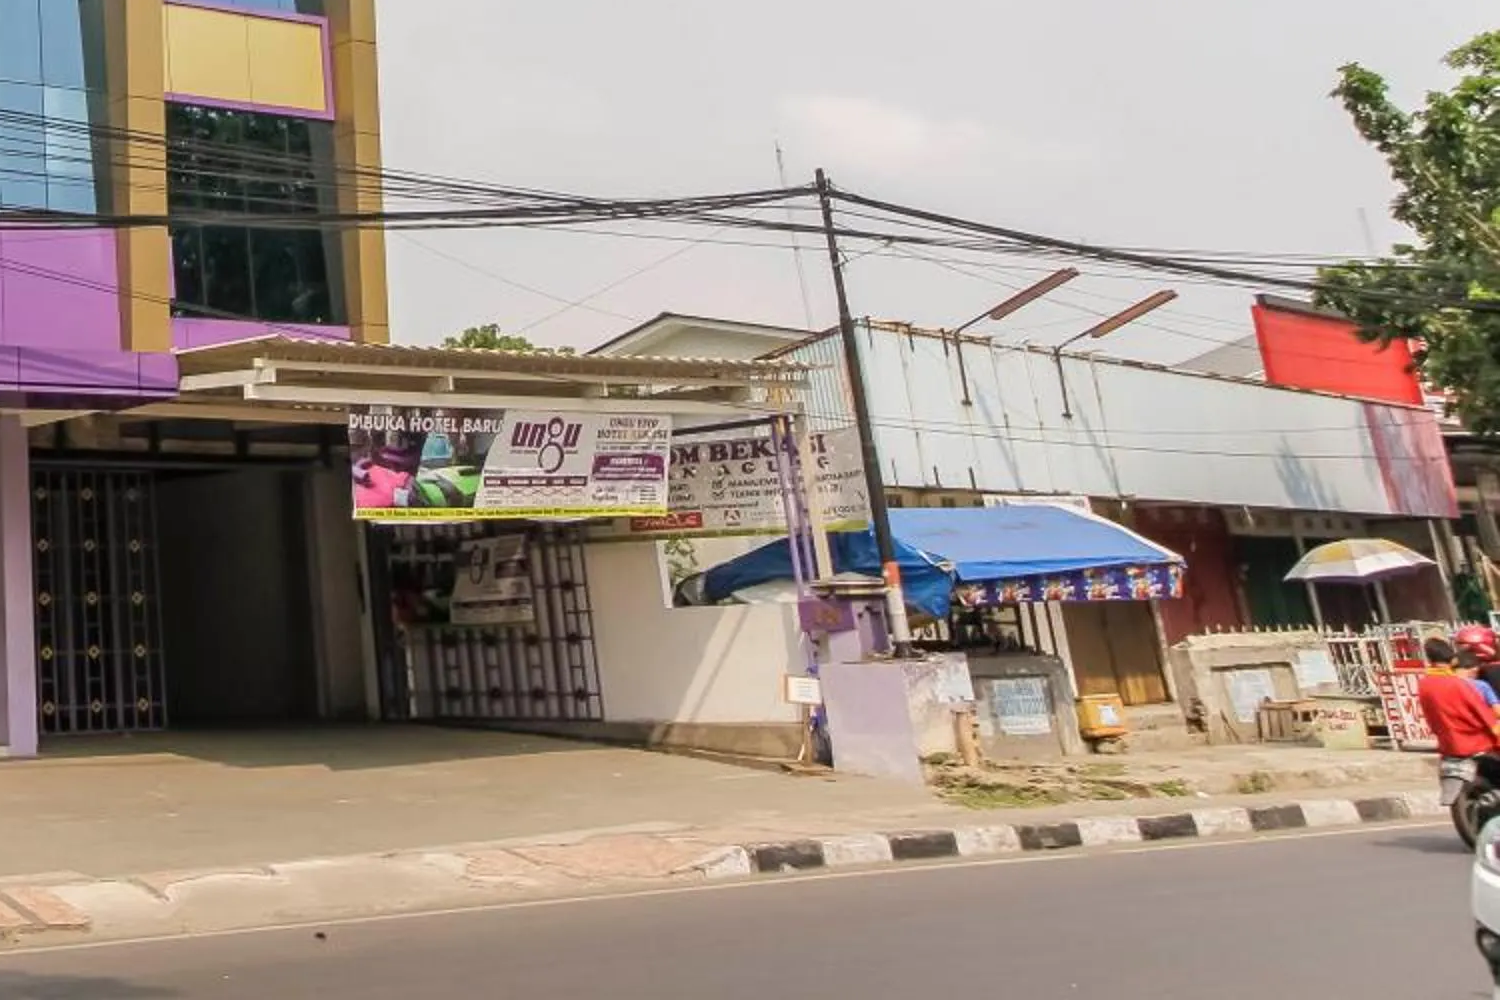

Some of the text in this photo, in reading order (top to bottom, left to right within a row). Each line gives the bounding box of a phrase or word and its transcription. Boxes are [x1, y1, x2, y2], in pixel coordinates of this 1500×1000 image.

[348, 413, 503, 433] DIBUKA HOTEL BARU
